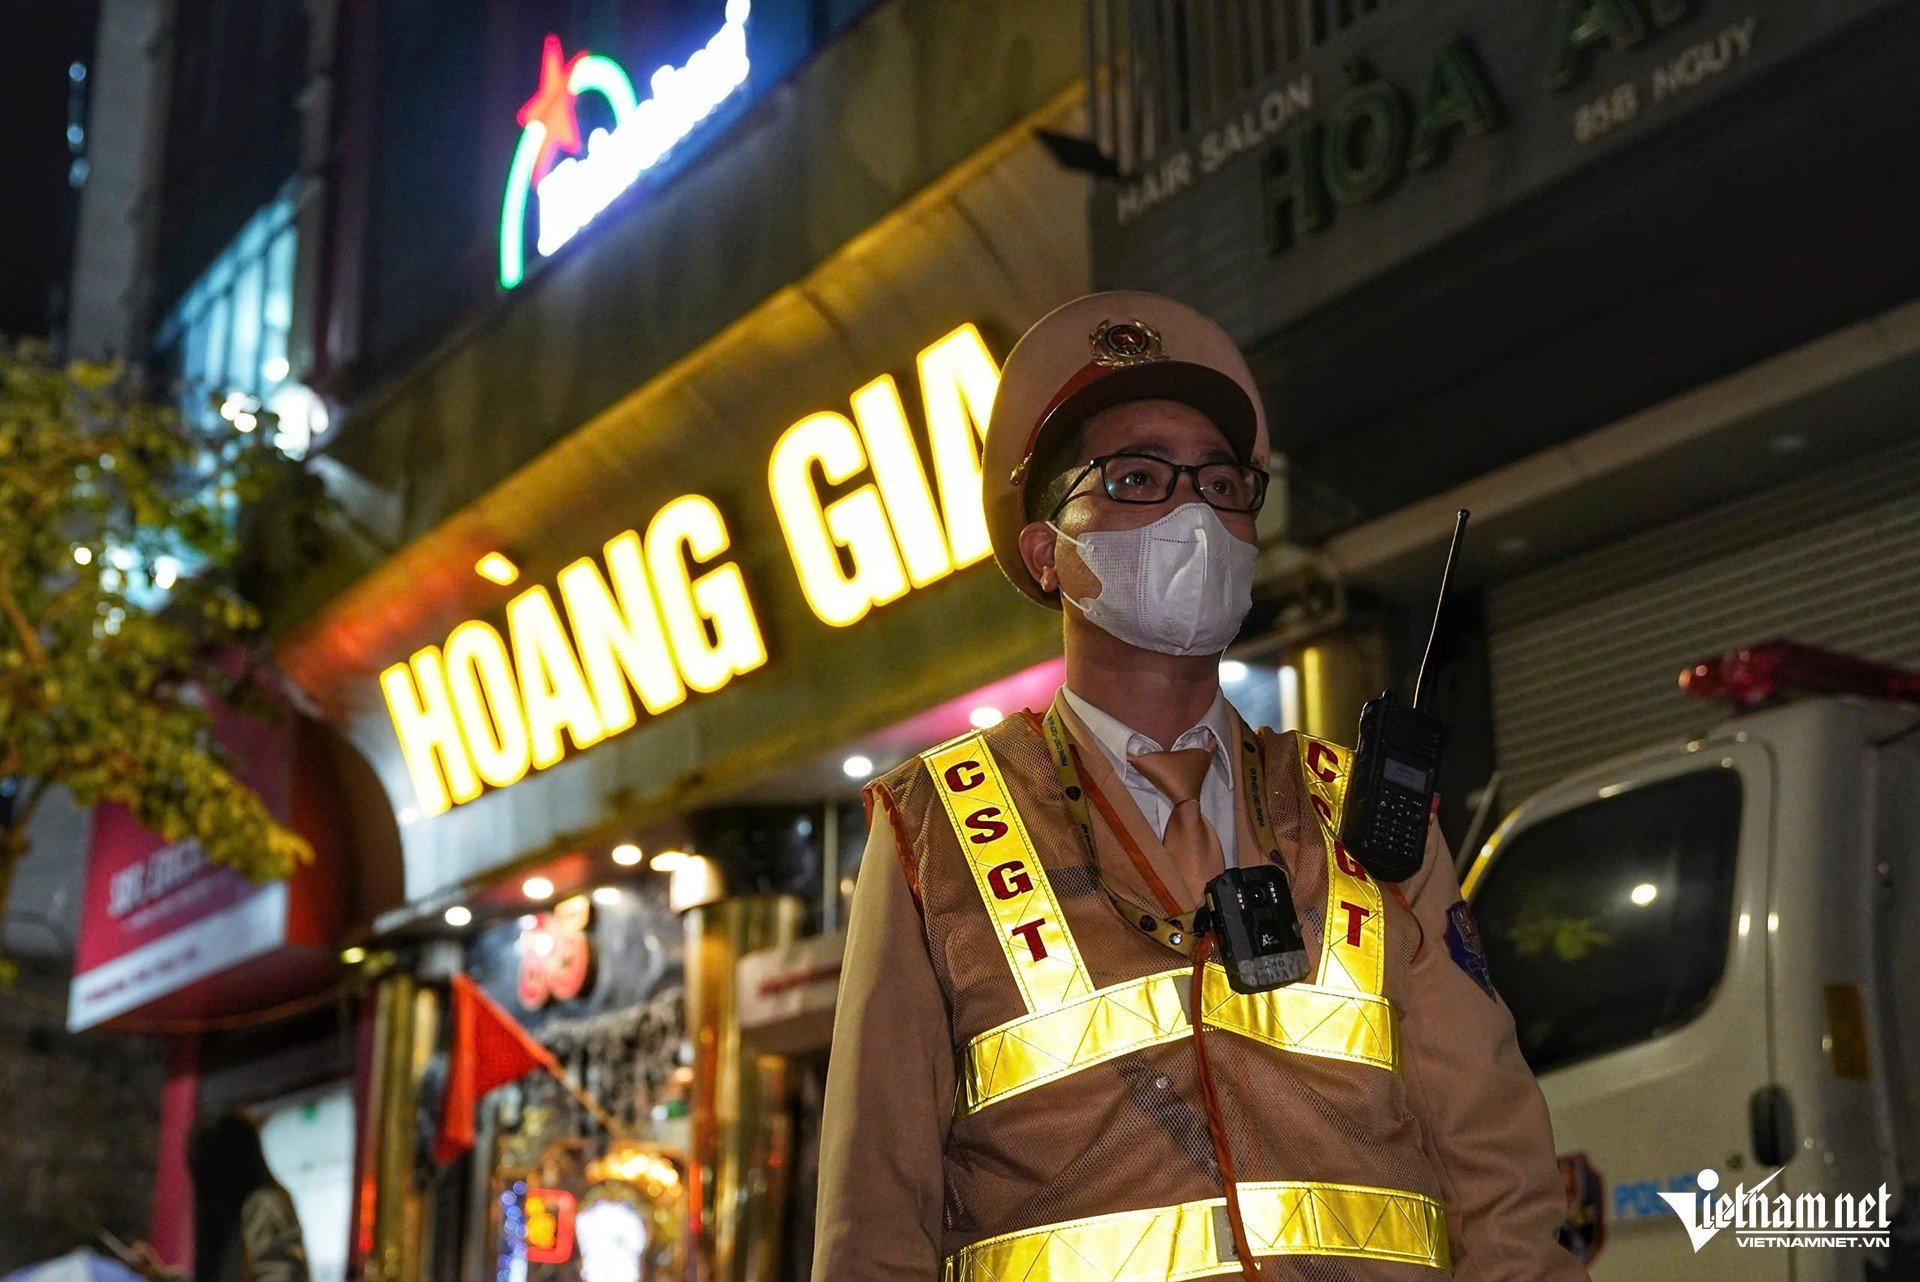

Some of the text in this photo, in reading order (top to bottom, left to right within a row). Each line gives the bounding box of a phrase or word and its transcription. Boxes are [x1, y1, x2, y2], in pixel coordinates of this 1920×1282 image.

[1116, 71, 1315, 225] HAIR SALON
[378, 321, 1002, 818] HOÀNG GIA
[944, 760, 1049, 963] CSGT
